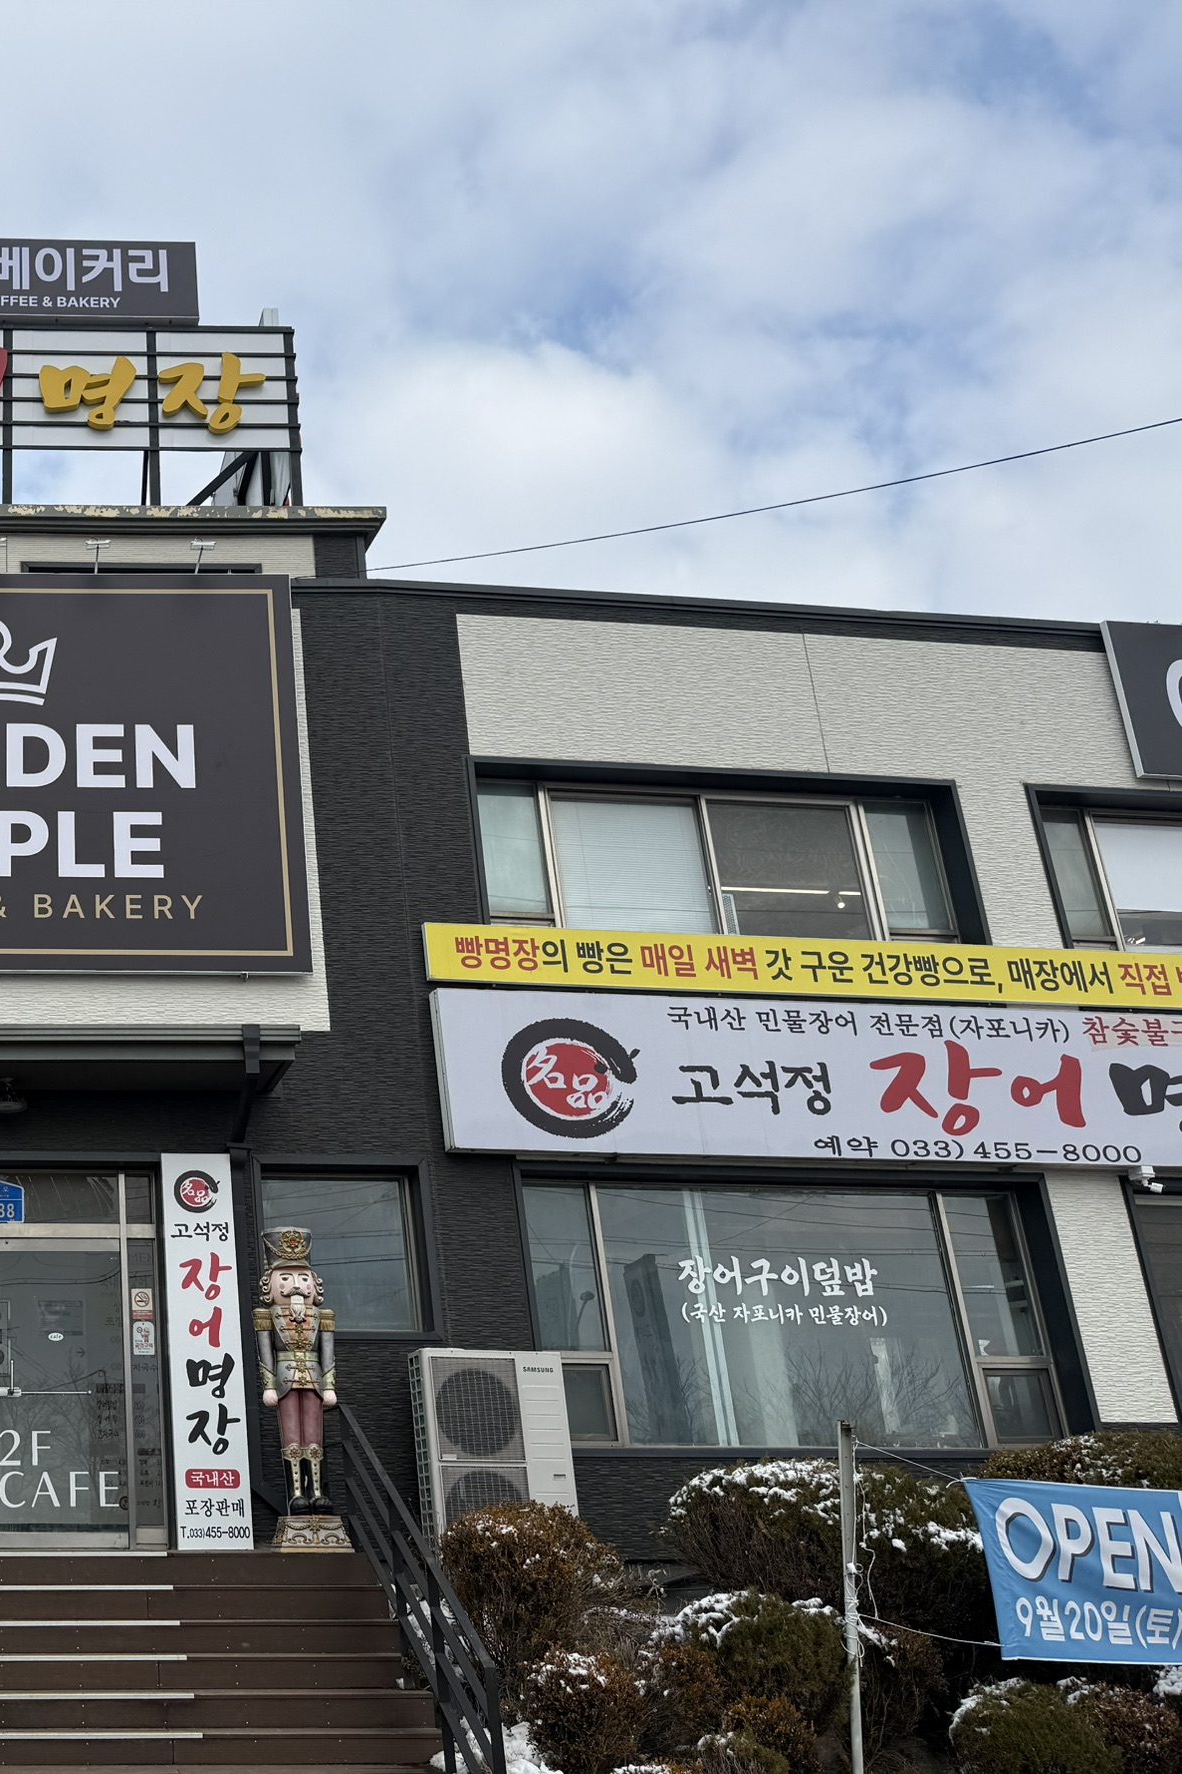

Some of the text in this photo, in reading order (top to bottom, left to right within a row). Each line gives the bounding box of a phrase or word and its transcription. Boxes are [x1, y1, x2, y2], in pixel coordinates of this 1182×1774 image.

[42, 296, 53, 307] &
[56, 296, 121, 308] BAKERY
[33, 893, 204, 920] BAKERY
[454, 935, 569, 974] 빵명장의
[576, 940, 634, 975] 빵은
[640, 943, 698, 979] 매일
[705, 946, 760, 981] 새벽
[765, 948, 793, 982] 갓
[800, 950, 854, 985] 구운
[1008, 957, 1115, 995] 매장에서
[1118, 963, 1173, 997] 직접
[666, 1005, 746, 1032] 국내산
[755, 1008, 858, 1037] 민물장어
[671, 1060, 833, 1116] 고석정
[869, 1039, 1087, 1137] 장어
[813, 1135, 880, 1158] 예약
[170, 1221, 230, 1242] 고석정
[677, 1255, 879, 1297] 장어구이덮밥
[681, 1301, 888, 1327] (국산 자포니카 민물장어)
[190, 1471, 235, 1487] 국내산
[184, 1498, 246, 1518] 포장판매
[995, 1497, 1182, 1594] OPEN
